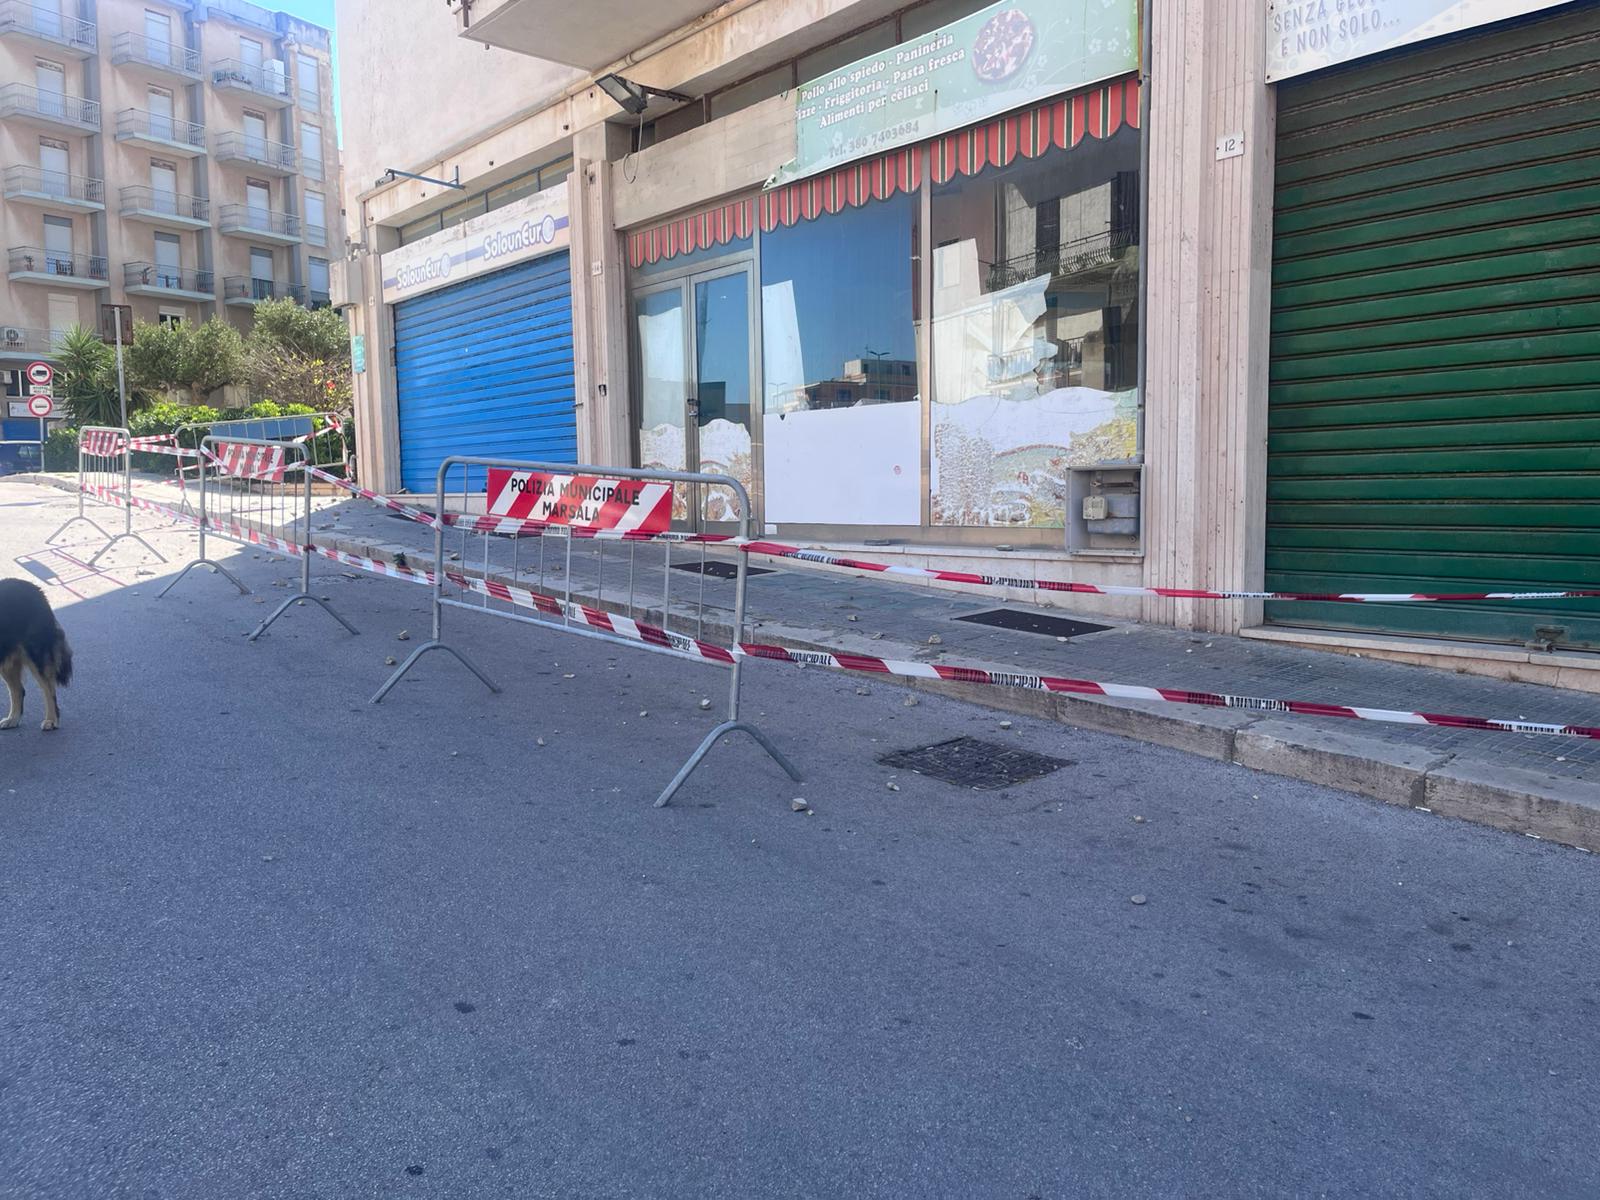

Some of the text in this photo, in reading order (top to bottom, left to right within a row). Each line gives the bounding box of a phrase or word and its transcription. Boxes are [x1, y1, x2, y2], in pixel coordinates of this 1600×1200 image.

[1273, 1, 1328, 33] SENZA
[1281, 38, 1288, 57] E
[1297, 24, 1330, 54] NON
[801, 84, 825, 102] Pollo
[828, 75, 847, 92] allo
[849, 60, 886, 83] spiedo
[895, 33, 954, 66] Panineria
[796, 104, 816, 121] izze
[824, 79, 882, 110] Friggitoria
[893, 65, 925, 84] Pasta
[928, 49, 966, 72] fresca
[819, 79, 929, 129] Alimenti per celiaci
[1224, 138, 1236, 152] 12
[511, 478, 640, 506] POLIZIA MUNICIPALE
[542, 501, 600, 522] MARSALA
